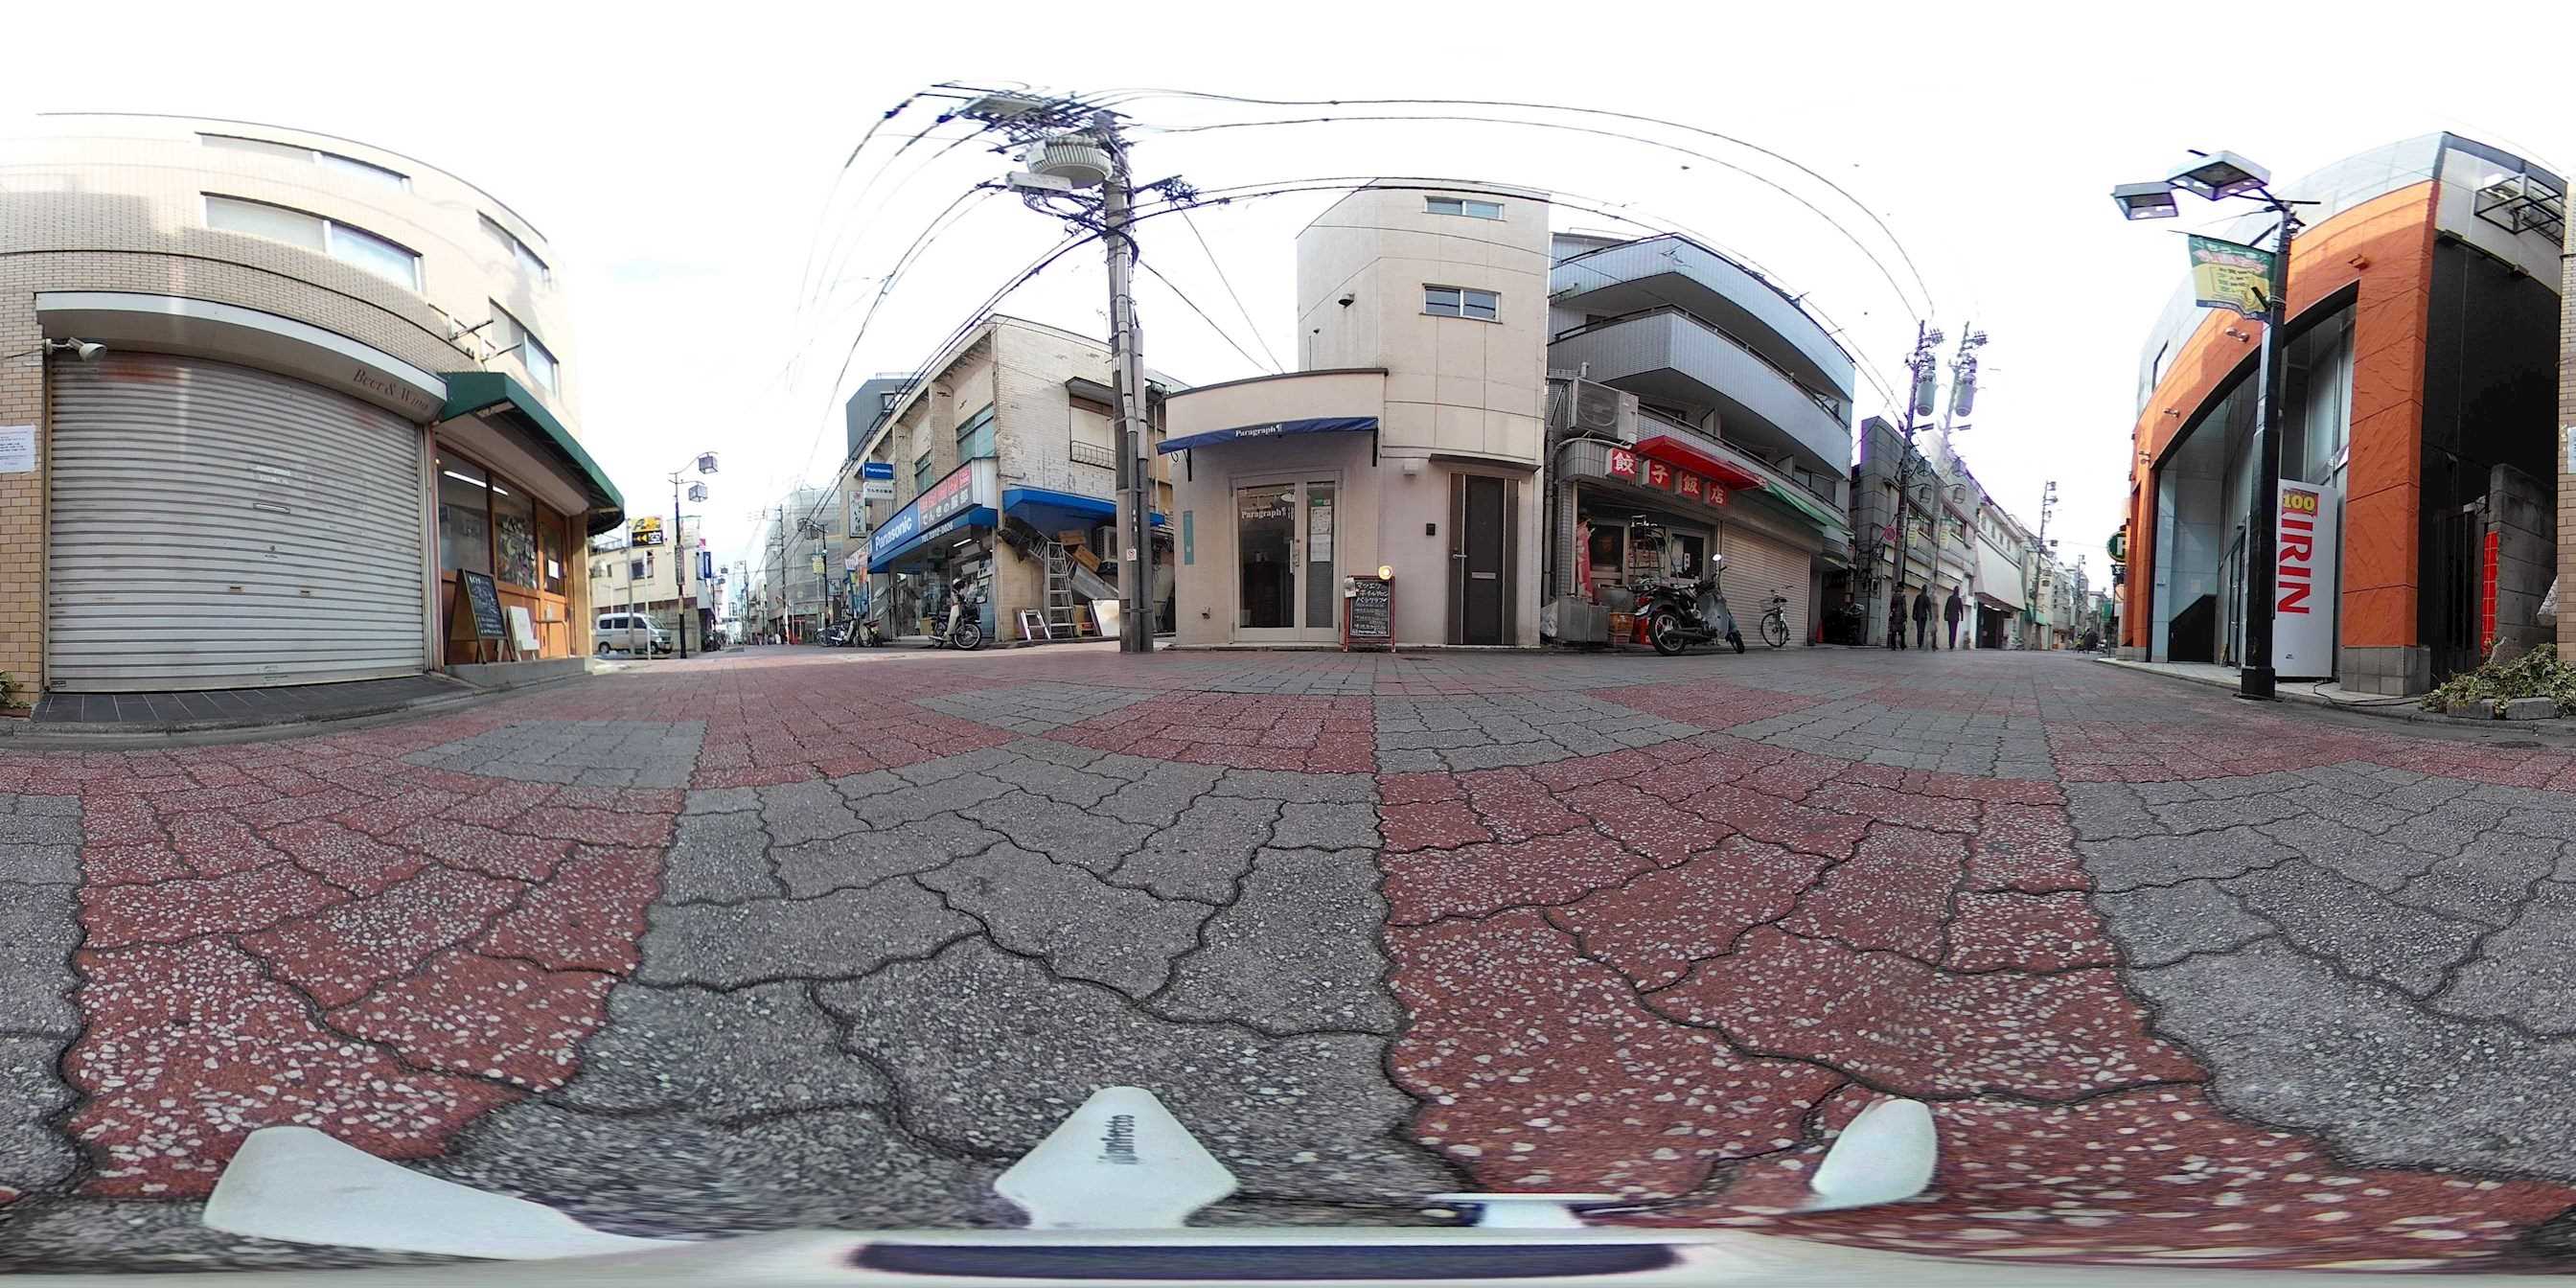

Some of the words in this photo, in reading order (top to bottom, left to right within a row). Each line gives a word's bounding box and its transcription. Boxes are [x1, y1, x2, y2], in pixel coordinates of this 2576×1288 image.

[1235, 426, 1276, 437] Paragraph
[1614, 451, 1725, 504] 餃子飯店
[1242, 508, 1281, 519] Paragraph
[2283, 494, 2315, 512] 100
[875, 517, 912, 551] Panasonic
[2277, 515, 2314, 614] IRIN
